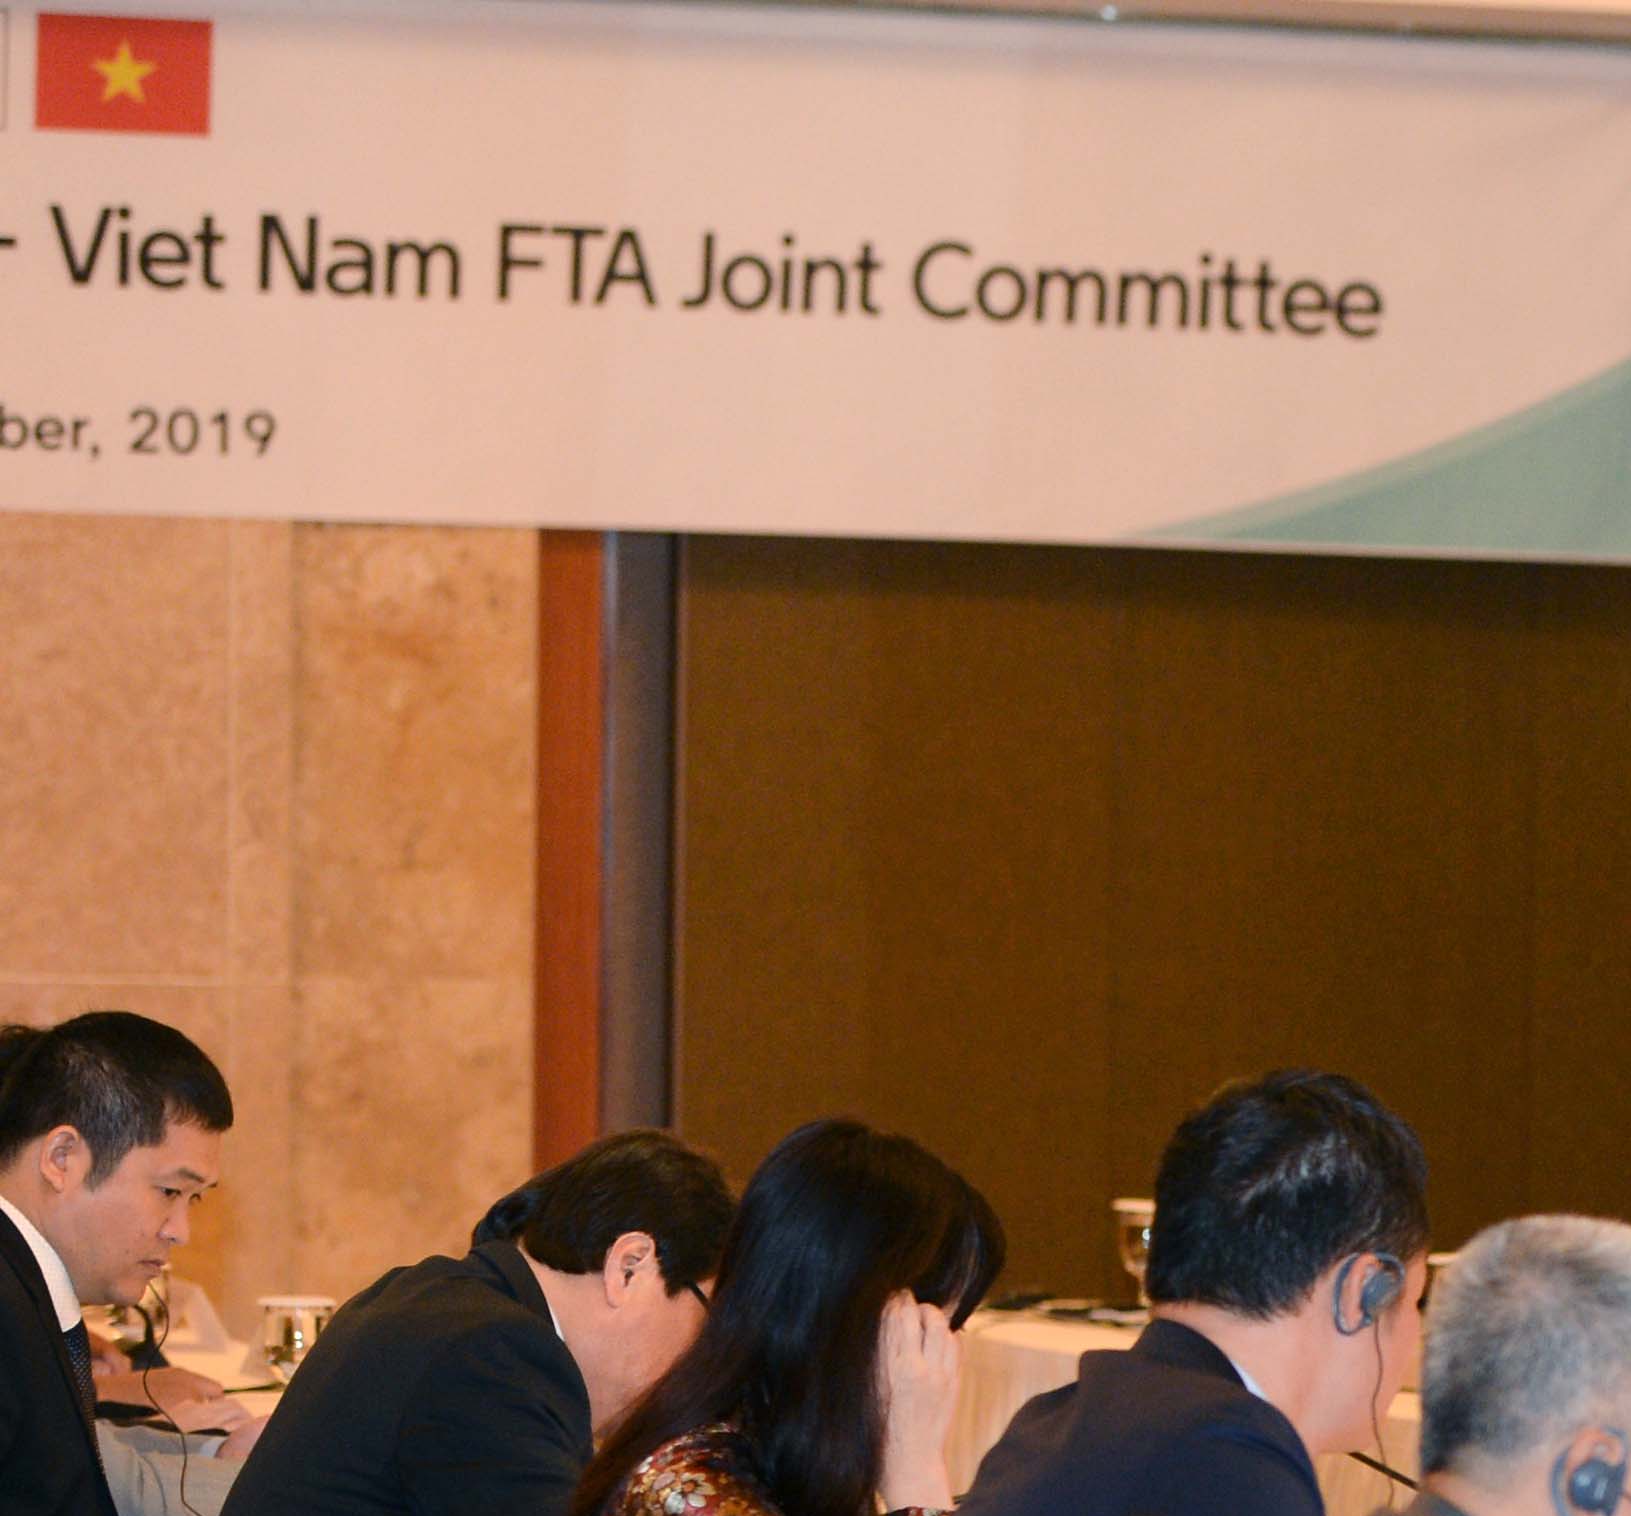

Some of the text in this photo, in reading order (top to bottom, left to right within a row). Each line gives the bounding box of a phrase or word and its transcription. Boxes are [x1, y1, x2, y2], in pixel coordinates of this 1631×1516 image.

[49, 204, 226, 291] Viet
[258, 213, 462, 299] Nam
[497, 222, 657, 307] FTA
[681, 232, 882, 316] Joint
[912, 240, 1384, 339] Committee
[129, 407, 276, 457] 2019
